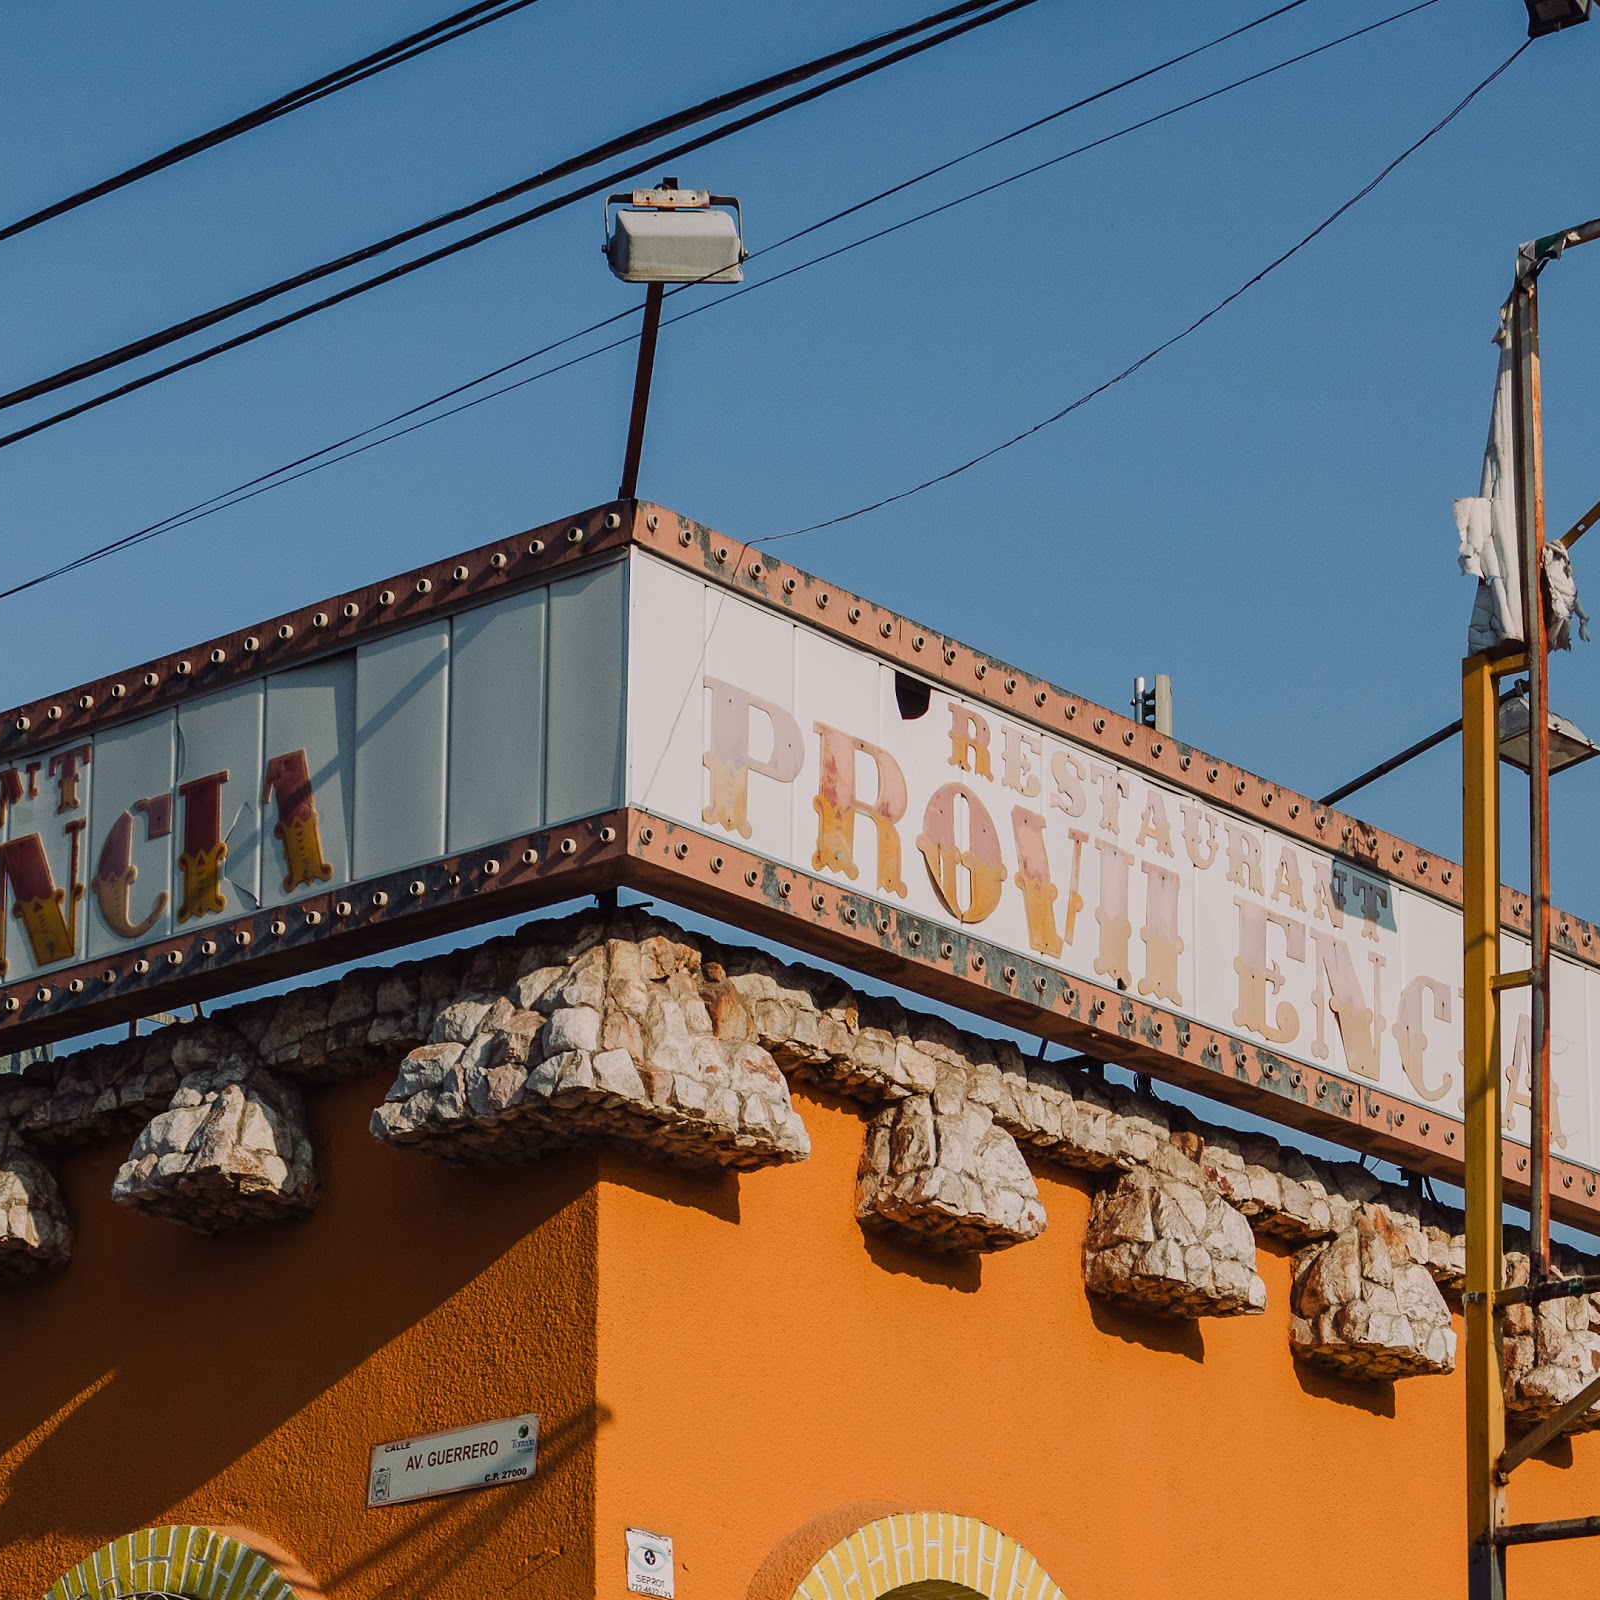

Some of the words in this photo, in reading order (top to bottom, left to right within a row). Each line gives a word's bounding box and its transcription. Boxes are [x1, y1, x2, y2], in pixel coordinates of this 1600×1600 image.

[947, 701, 1388, 943] RESTAURANT
[385, 1442, 411, 1453] CALLE
[405, 1454, 424, 1472] AV.
[427, 1440, 499, 1467] GUERRERO
[485, 1473, 501, 1482] C.P.
[501, 1467, 528, 1479] 27000
[636, 1574, 665, 1588] SEPROT
